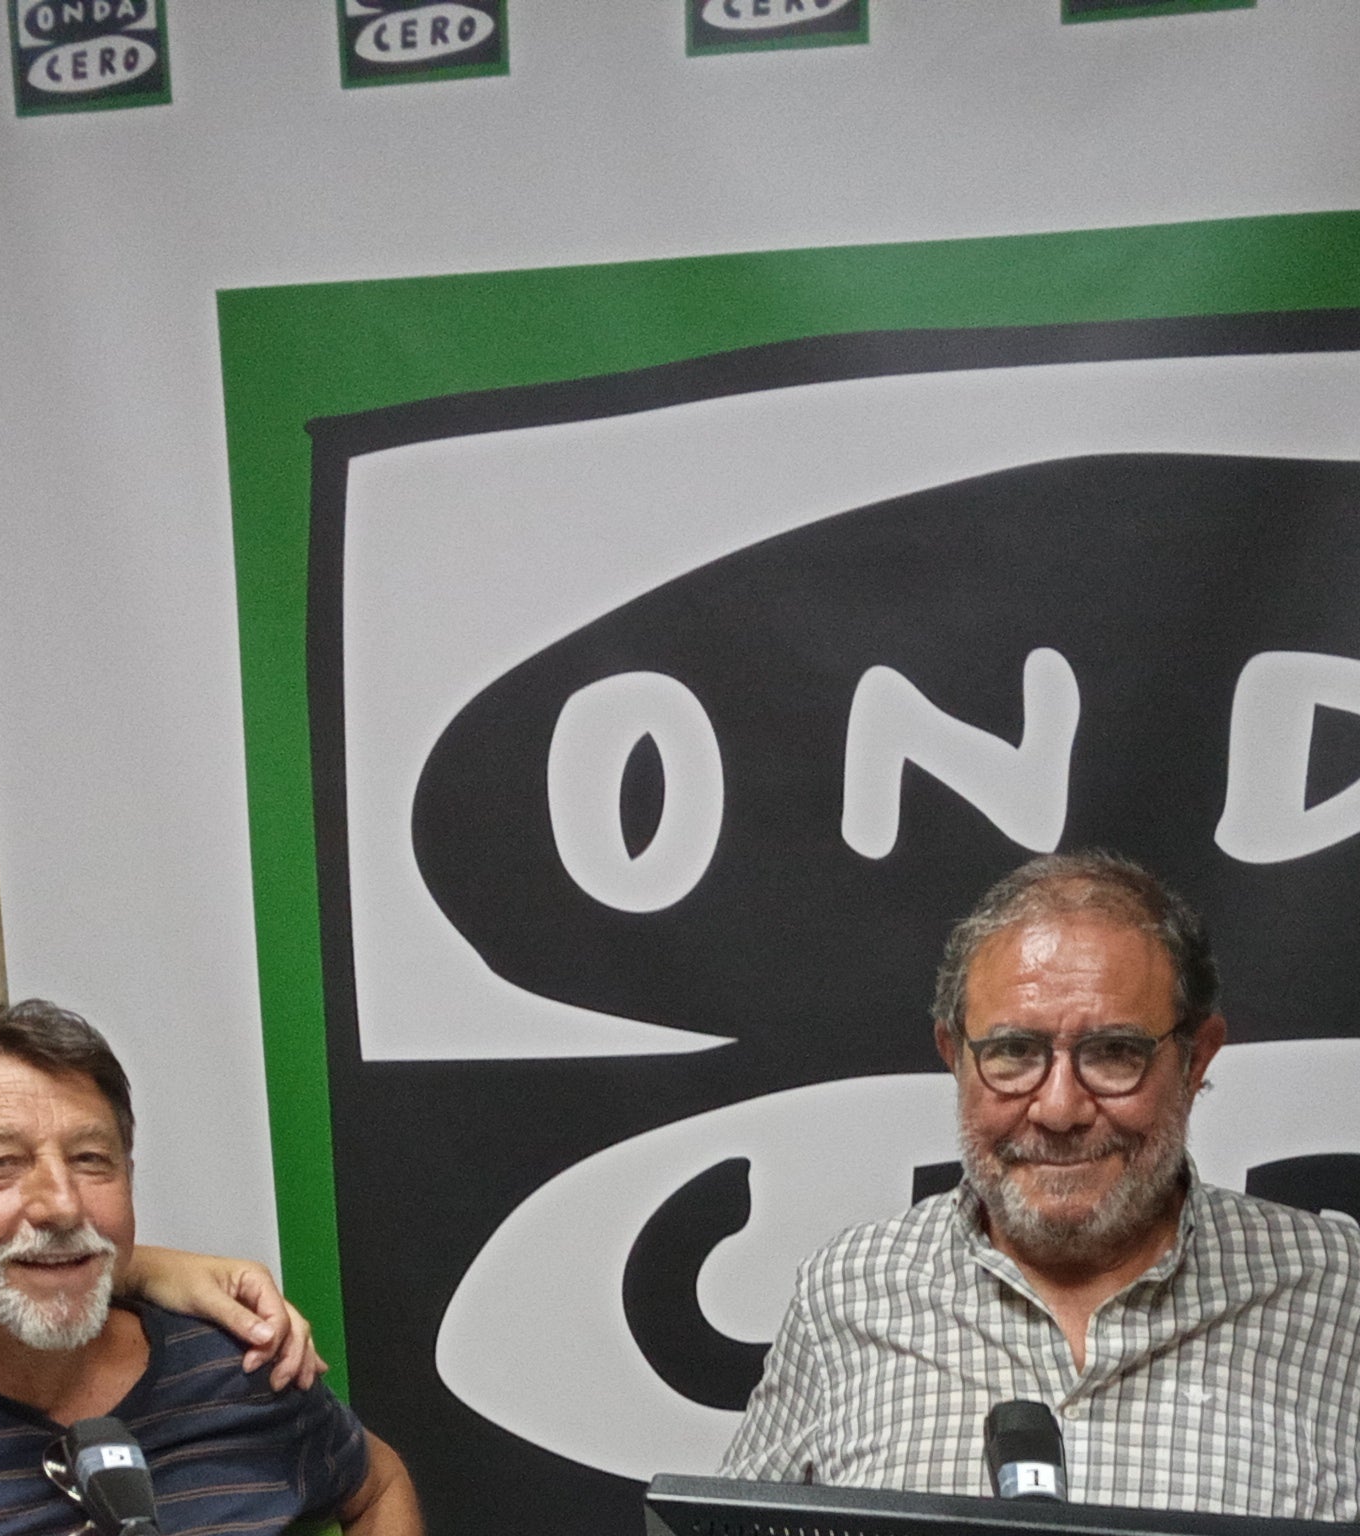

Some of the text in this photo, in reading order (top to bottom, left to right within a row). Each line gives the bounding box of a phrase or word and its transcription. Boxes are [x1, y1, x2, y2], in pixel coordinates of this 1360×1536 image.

[36, 0, 136, 31] ONDA
[372, 15, 478, 53] CERO
[46, 46, 139, 83] CERO
[1026, 1468, 1047, 1488] 1
